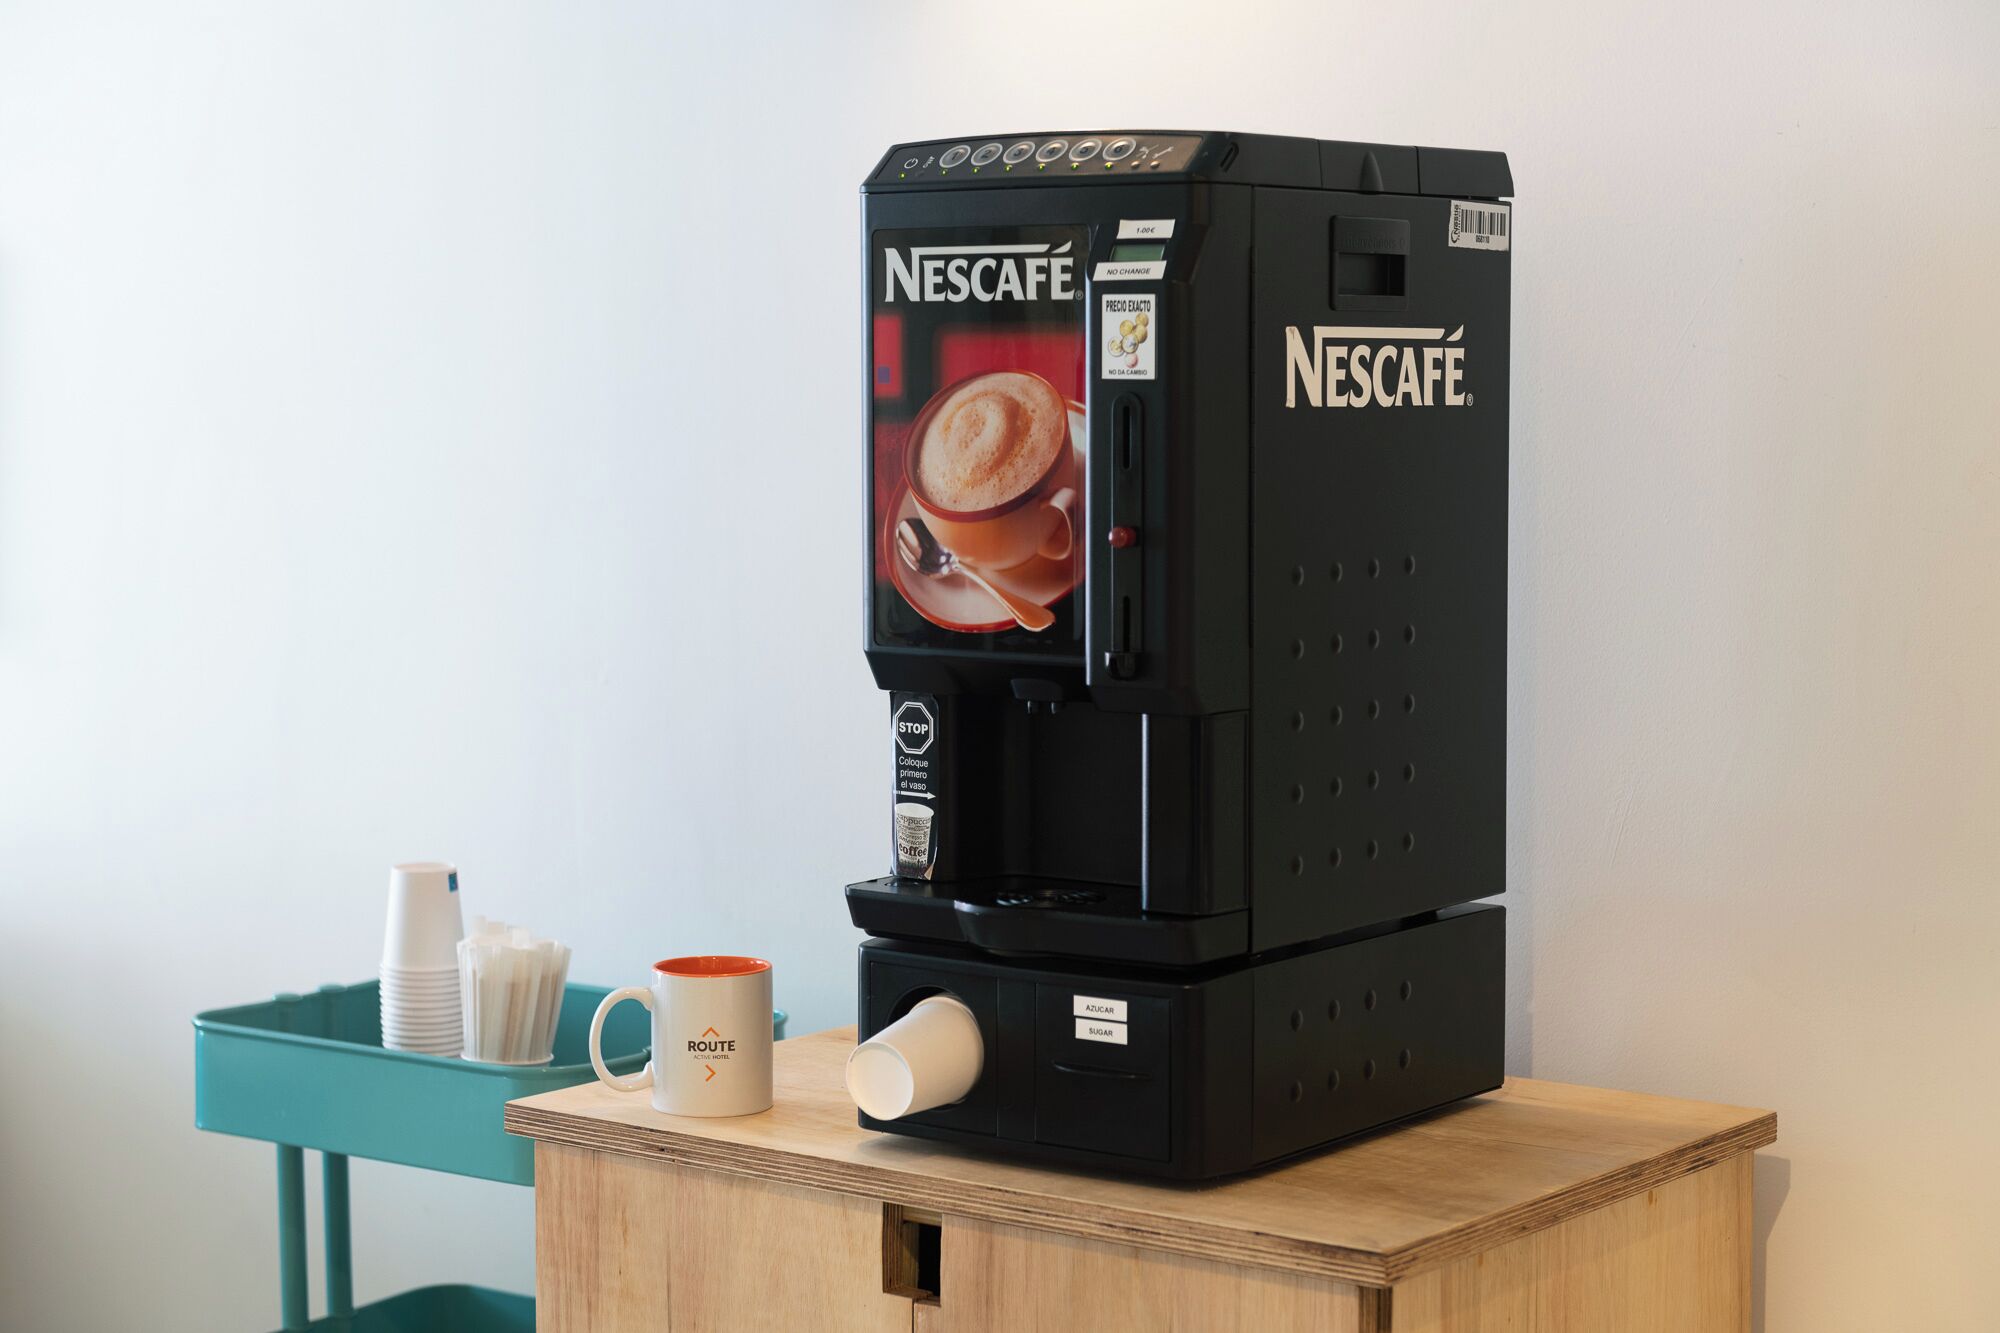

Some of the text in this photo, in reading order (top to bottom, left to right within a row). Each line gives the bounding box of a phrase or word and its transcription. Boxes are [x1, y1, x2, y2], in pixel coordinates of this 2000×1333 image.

[884, 240, 1076, 302] NESCAFÉ
[1106, 267, 1151, 276] NO CHANGE
[1105, 299, 1151, 313] PRECIO EXACTO
[1285, 324, 1466, 408] NESCAFÉ
[899, 721, 929, 735] STOP
[898, 756, 929, 769] Coloque
[900, 769, 928, 779] primero
[900, 780, 927, 791] el vaso
[899, 843, 928, 858] coffee
[1085, 1004, 1115, 1014] AZUCAR
[1088, 1027, 1113, 1037] SUGAR
[687, 1040, 736, 1052] ROUTE
